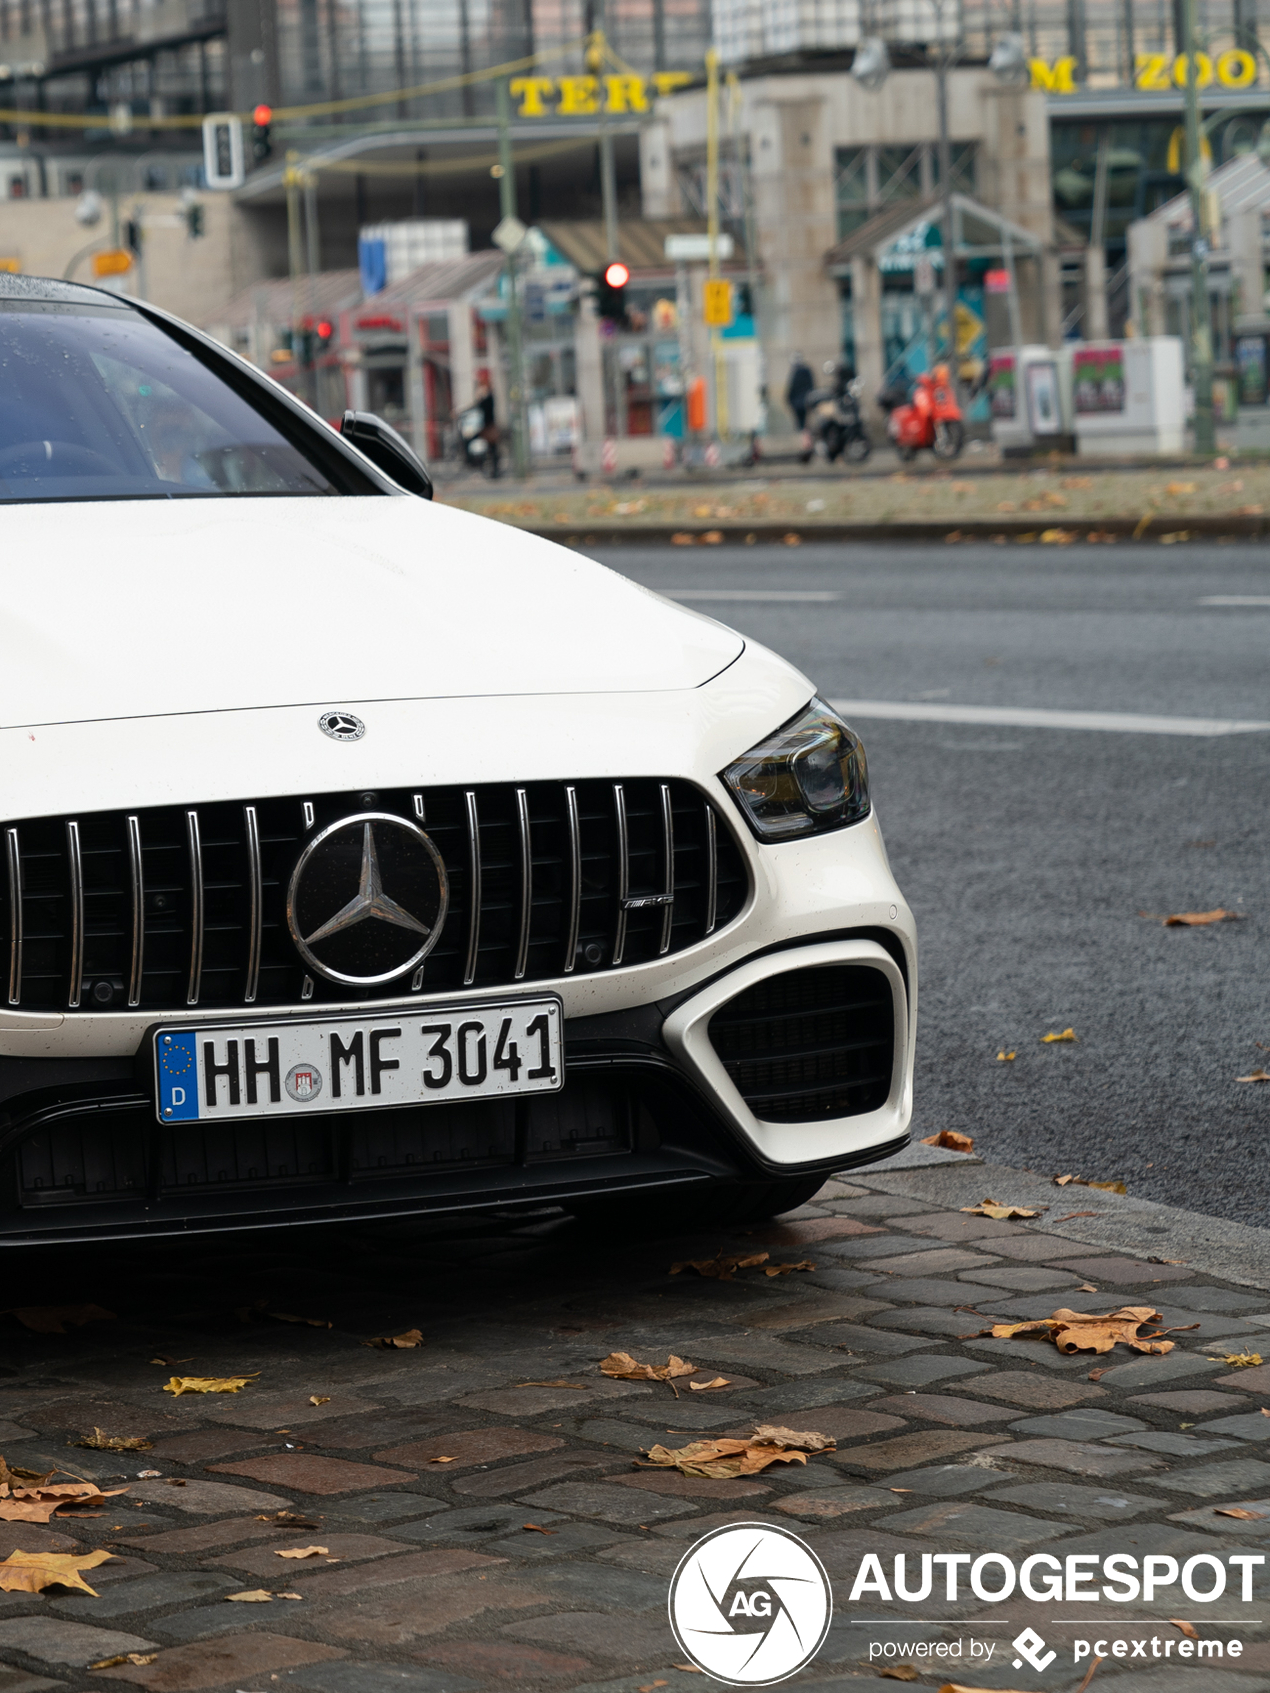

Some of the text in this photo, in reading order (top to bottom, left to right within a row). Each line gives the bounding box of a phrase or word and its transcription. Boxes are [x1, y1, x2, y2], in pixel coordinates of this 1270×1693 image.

[1134, 49, 1256, 92] ZOO
[203, 1037, 281, 1107] HH
[329, 1028, 402, 1098] MF
[421, 1014, 556, 1089] 3041
[171, 1087, 186, 1106] D
